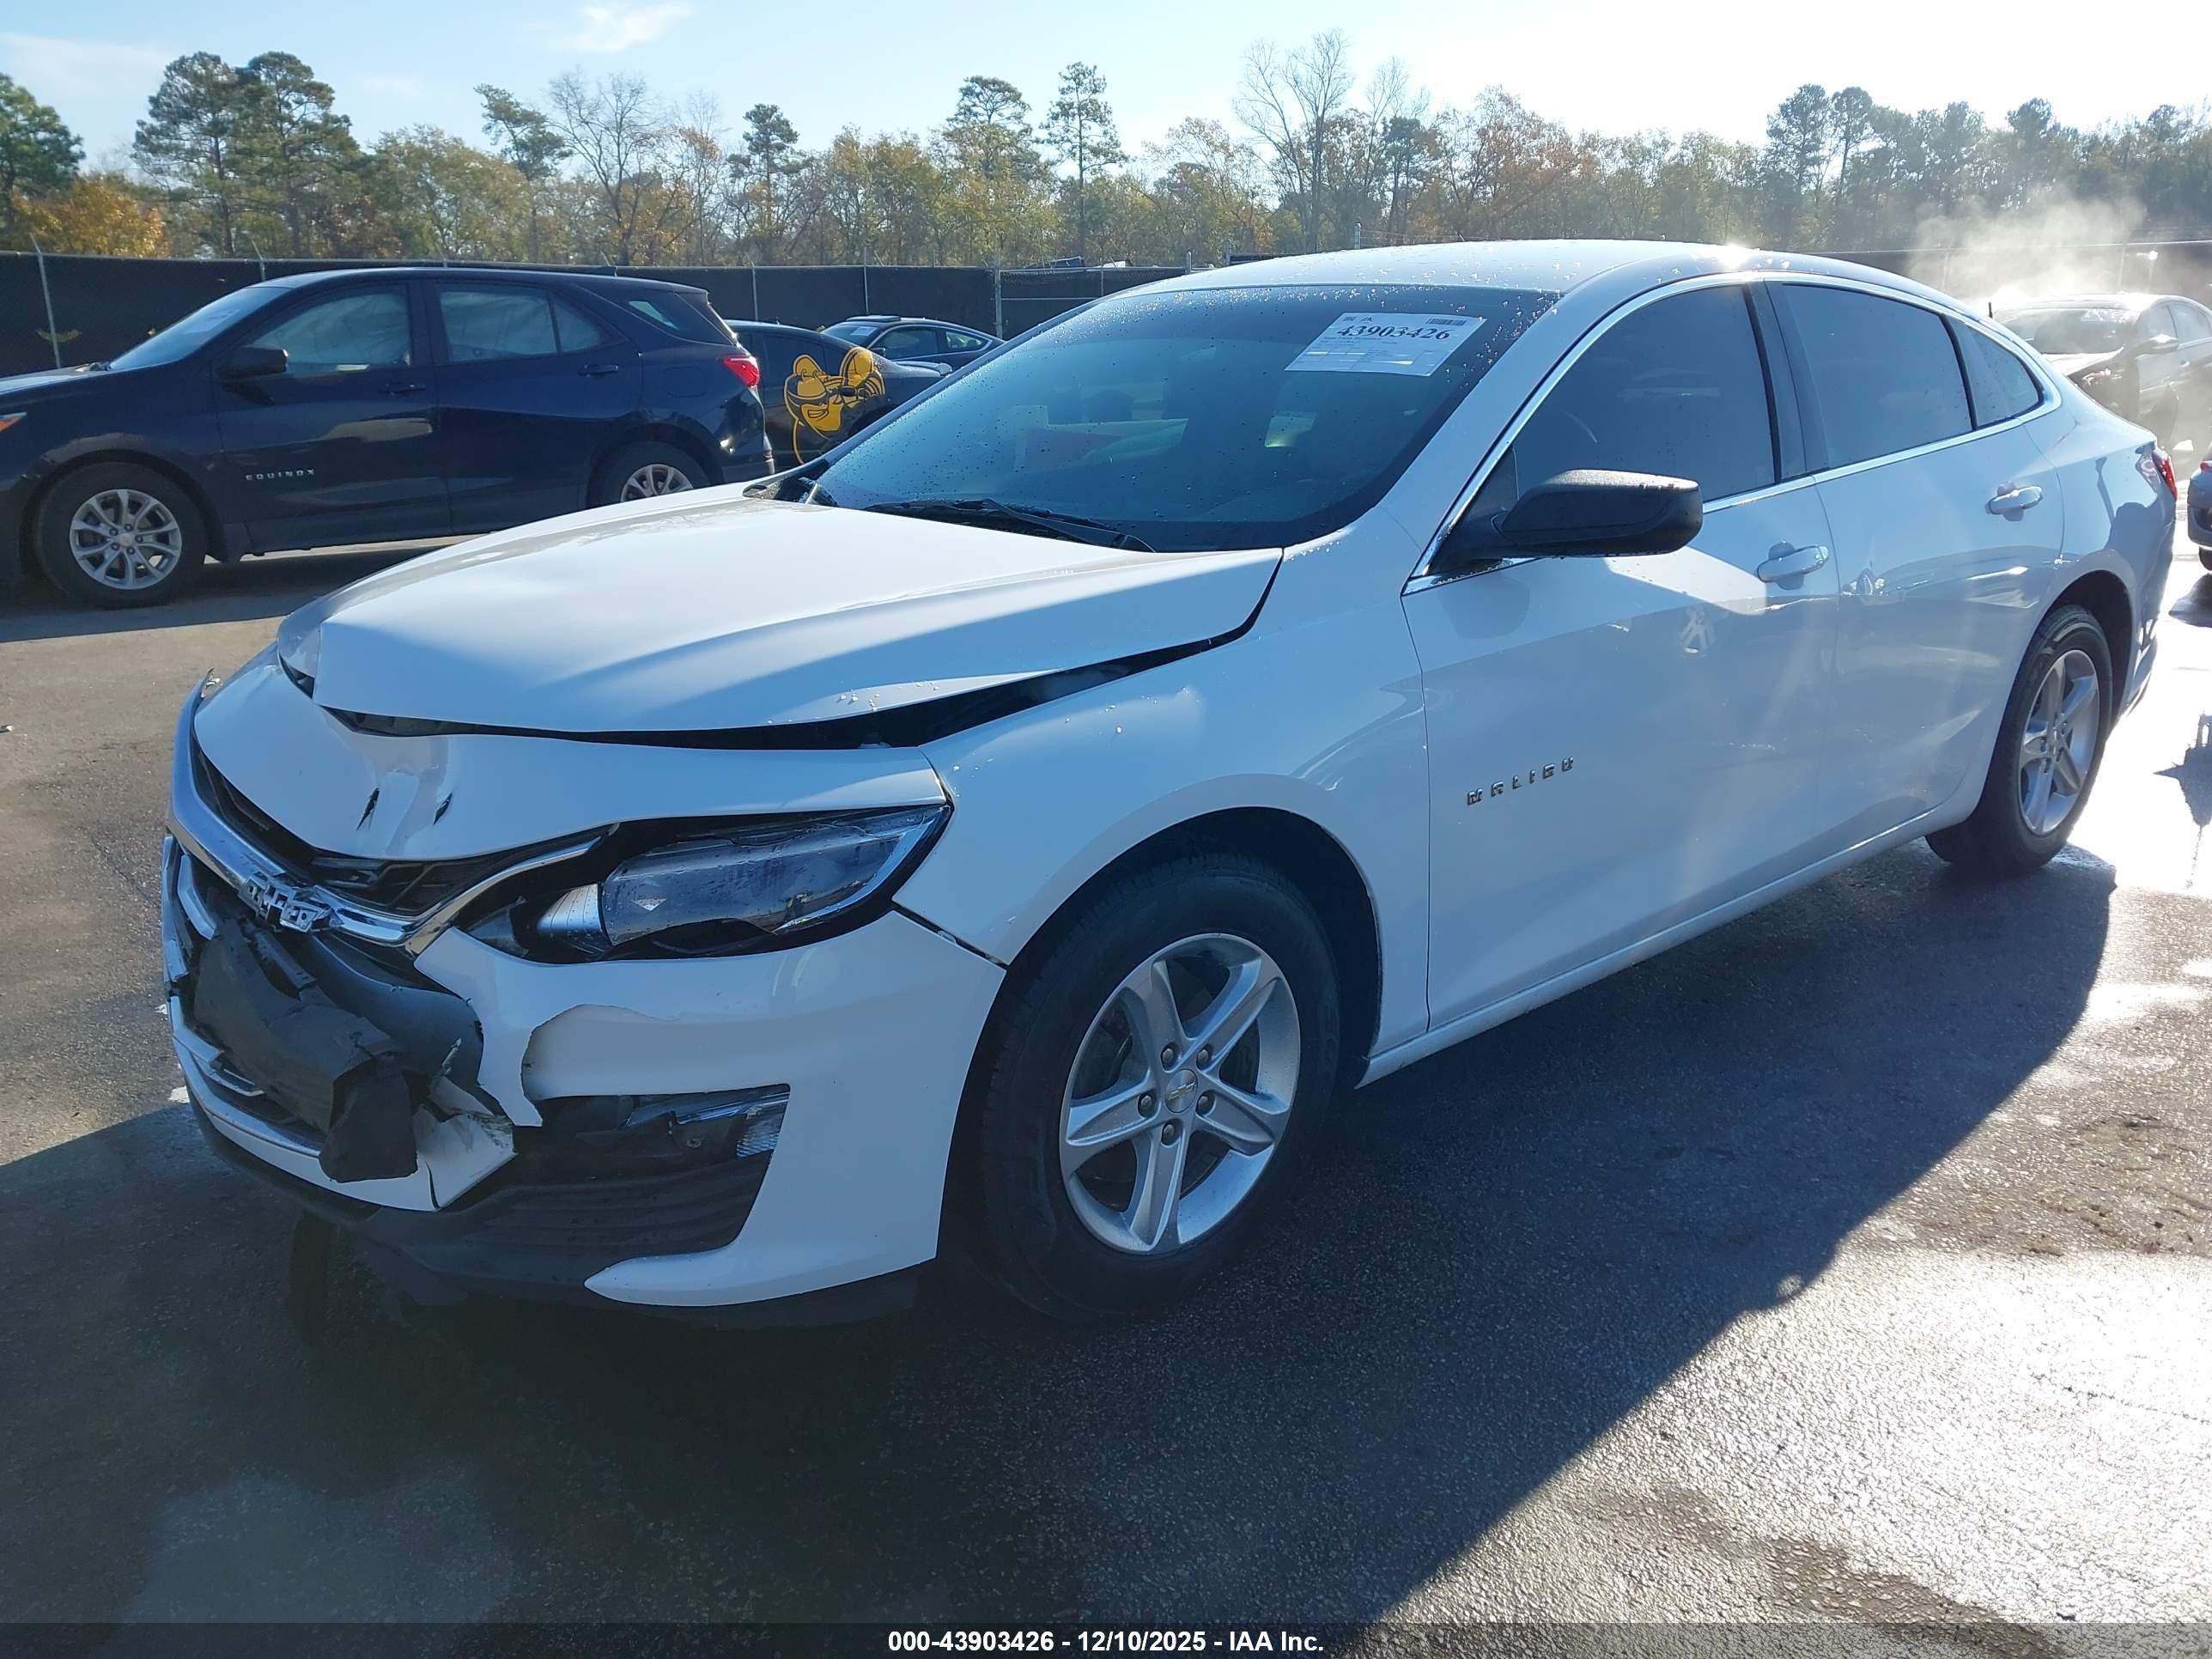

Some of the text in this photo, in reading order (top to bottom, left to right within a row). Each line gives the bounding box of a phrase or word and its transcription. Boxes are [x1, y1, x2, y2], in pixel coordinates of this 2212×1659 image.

[1337, 325, 1455, 341] 43903426
[245, 469, 314, 481] EQUINOX
[1467, 756, 1574, 805] MALIBU
